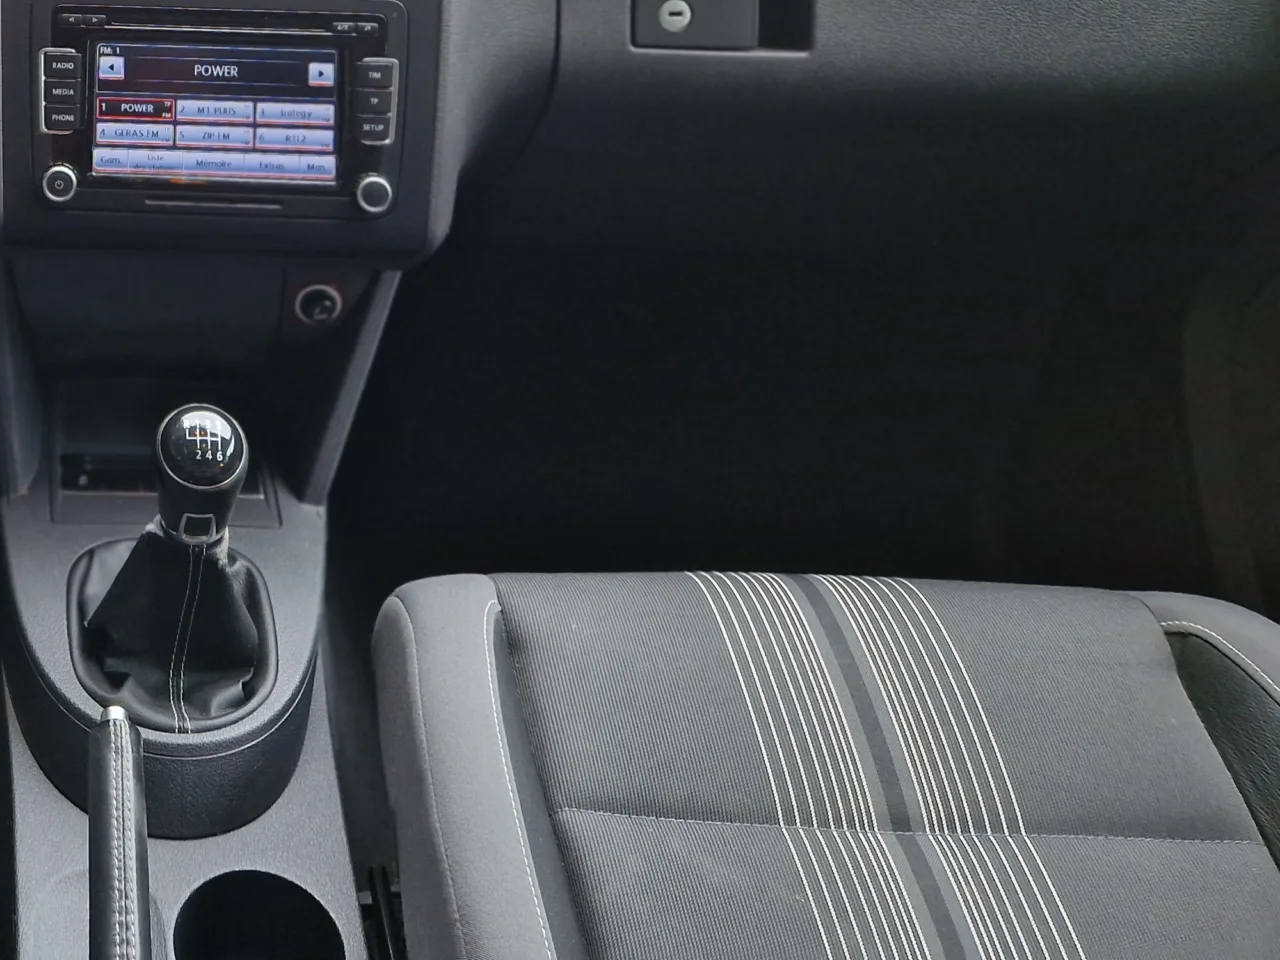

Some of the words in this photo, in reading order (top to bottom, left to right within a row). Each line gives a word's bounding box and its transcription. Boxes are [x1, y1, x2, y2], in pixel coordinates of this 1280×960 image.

[52, 62, 74, 70] RADIO
[194, 64, 239, 77] POWER
[368, 71, 381, 79] TIM
[52, 88, 74, 96] MEDIA
[370, 97, 379, 105] TP
[101, 102, 106, 111] 1
[121, 103, 154, 113] POWER
[51, 114, 74, 122] PHONE
[362, 124, 384, 132] SETUP
[100, 128, 106, 136] 4
[115, 128, 144, 138] GERAS
[147, 129, 159, 138] FM
[202, 132, 214, 140] ZIP
[195, 450, 202, 460] 2
[205, 451, 213, 460] 4
[216, 451, 223, 461] 6
